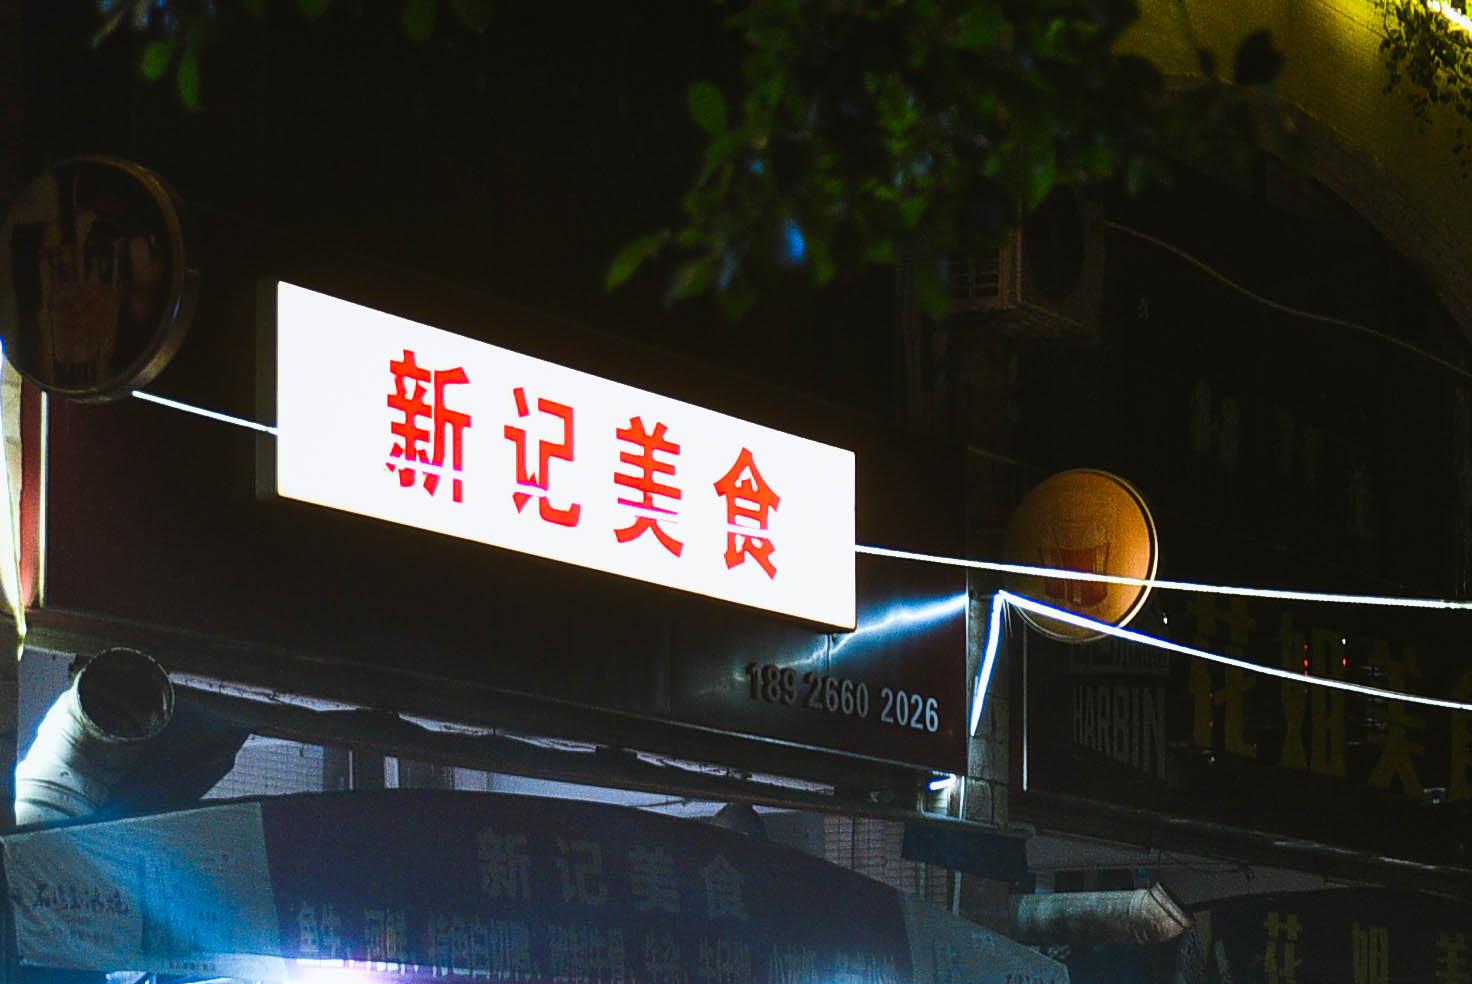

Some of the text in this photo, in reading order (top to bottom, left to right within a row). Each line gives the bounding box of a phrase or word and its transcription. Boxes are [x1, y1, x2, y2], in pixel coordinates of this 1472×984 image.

[387, 350, 781, 580] 新记美食
[746, 661, 940, 733] 189 2660 2026
[1072, 685, 1168, 783] HARBIN
[477, 827, 748, 920] 新记美食
